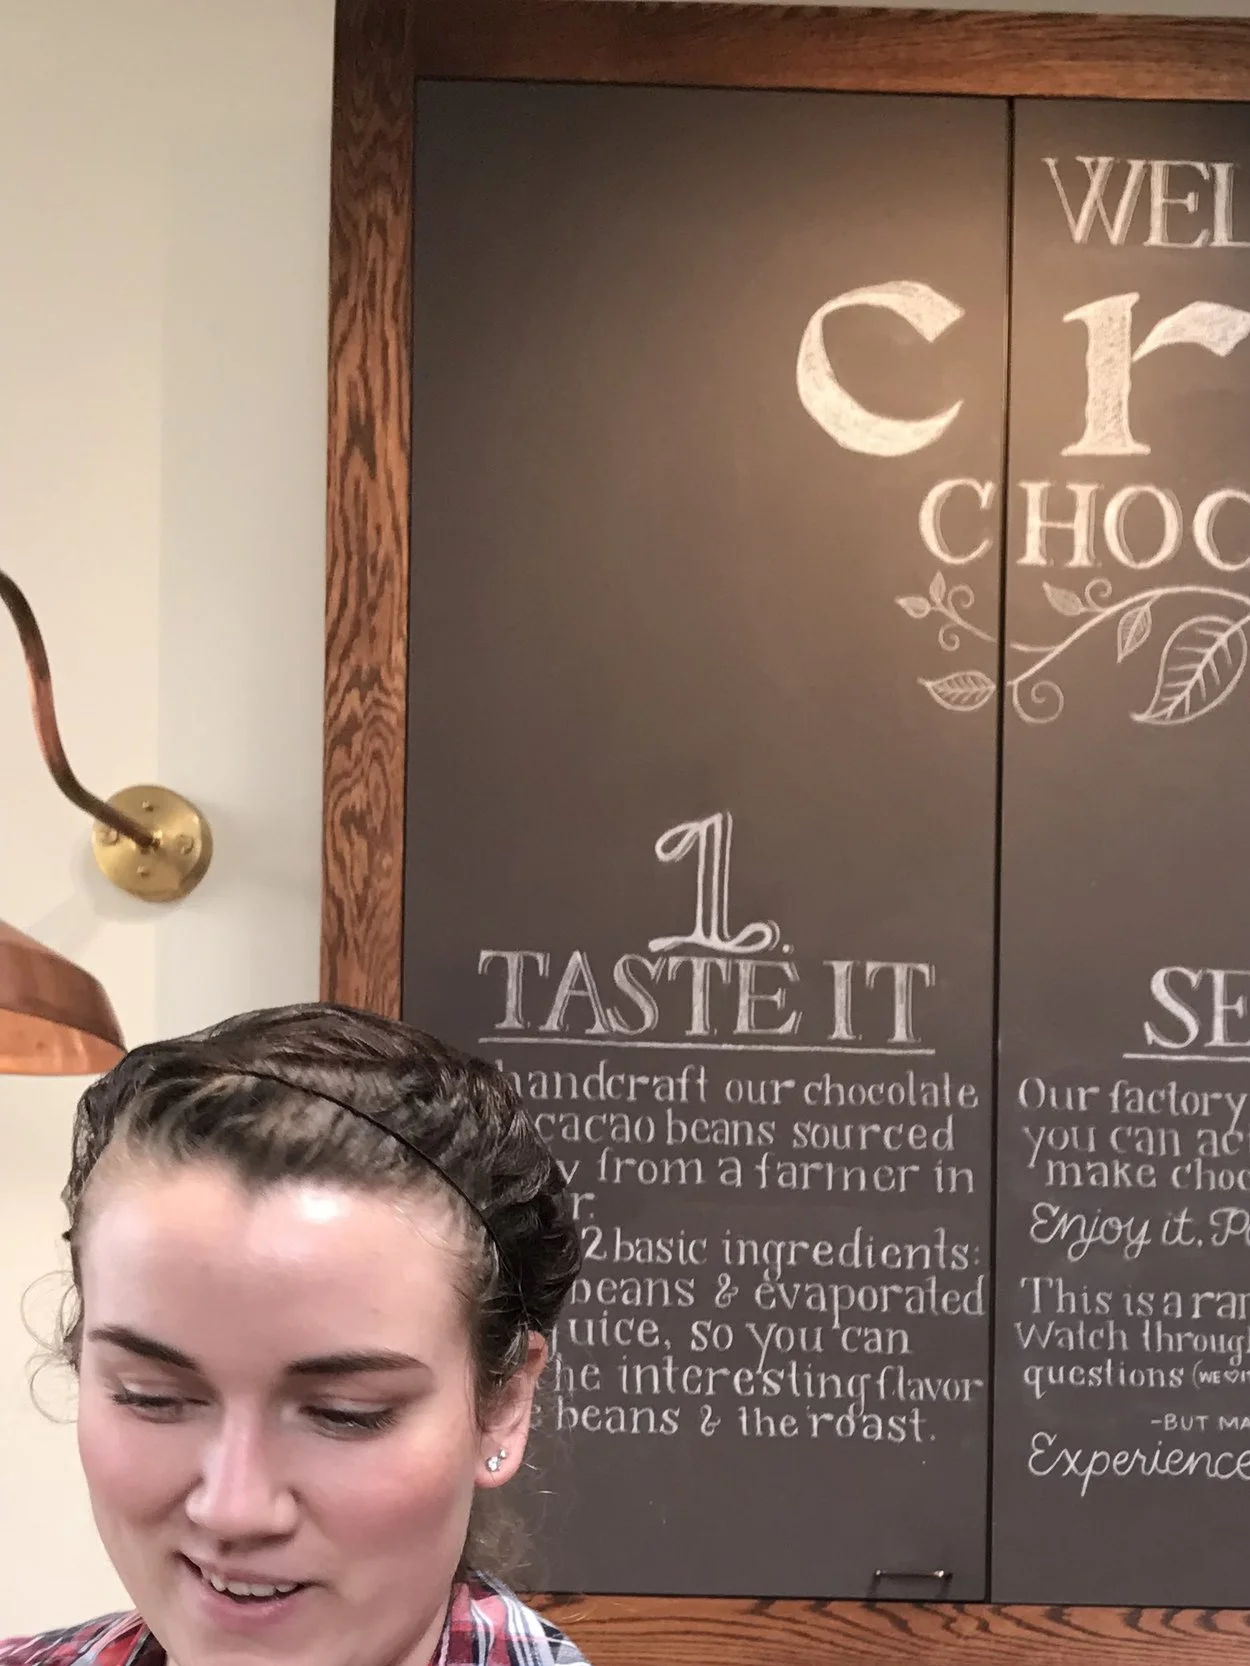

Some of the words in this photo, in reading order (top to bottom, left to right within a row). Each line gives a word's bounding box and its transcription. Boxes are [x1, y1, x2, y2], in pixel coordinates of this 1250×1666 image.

[478, 949, 803, 1037] TASTE
[823, 959, 937, 1044] IT
[725, 1078, 796, 1105] our
[803, 1069, 979, 1109] chocolate
[1018, 1076, 1100, 1112] Our
[1109, 1079, 1248, 1134] factory
[534, 1111, 656, 1144] cacao
[667, 1108, 776, 1147] beans
[792, 1114, 955, 1151] sourced
[1021, 1125, 1097, 1169] you
[1109, 1125, 1181, 1158] can
[598, 1146, 705, 1185] from
[718, 1156, 743, 1188] a
[753, 1151, 921, 1193] farmer
[933, 1160, 975, 1194] in
[1045, 1156, 1157, 1188] make
[581, 1225, 607, 1261] 2
[613, 1226, 708, 1266] basic
[1029, 1201, 1152, 1263] Enjoy
[714, 1272, 739, 1309] &
[754, 1274, 986, 1330] evaporated
[1020, 1276, 1113, 1316] This
[1123, 1284, 1155, 1317] is
[1162, 1290, 1183, 1319] a
[690, 1319, 734, 1352] so
[745, 1321, 824, 1374] you
[841, 1325, 912, 1355] can
[1014, 1319, 1129, 1351] Watch
[534, 1352, 601, 1393] he
[617, 1354, 872, 1418] interesting
[876, 1364, 985, 1402] flavor
[1023, 1357, 1185, 1400] questions
[699, 1403, 722, 1437] &
[737, 1405, 800, 1438] the
